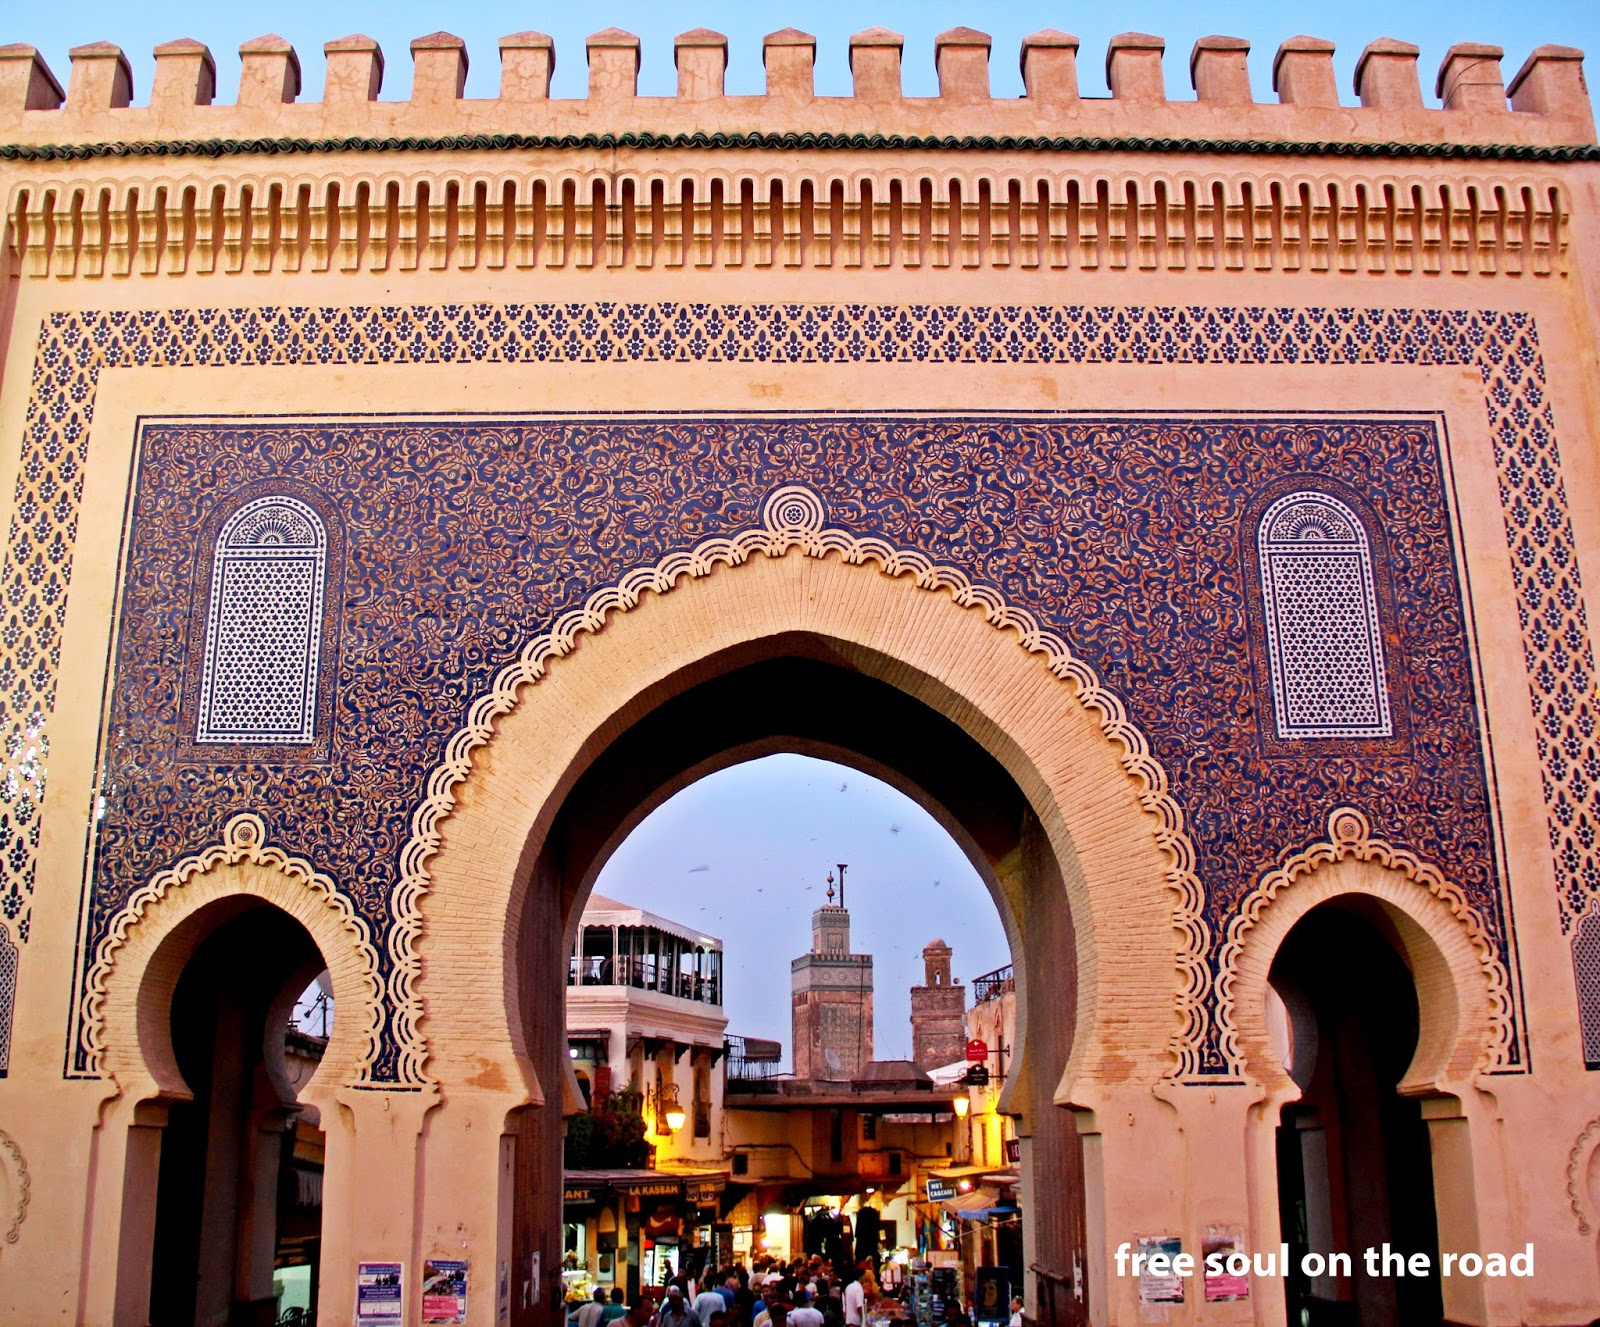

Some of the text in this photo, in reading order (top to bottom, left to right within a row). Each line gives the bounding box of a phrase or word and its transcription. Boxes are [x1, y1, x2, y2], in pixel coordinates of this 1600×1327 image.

[629, 1185, 679, 1196] LA KASBAH
[930, 1188, 954, 1197] CASCADE
